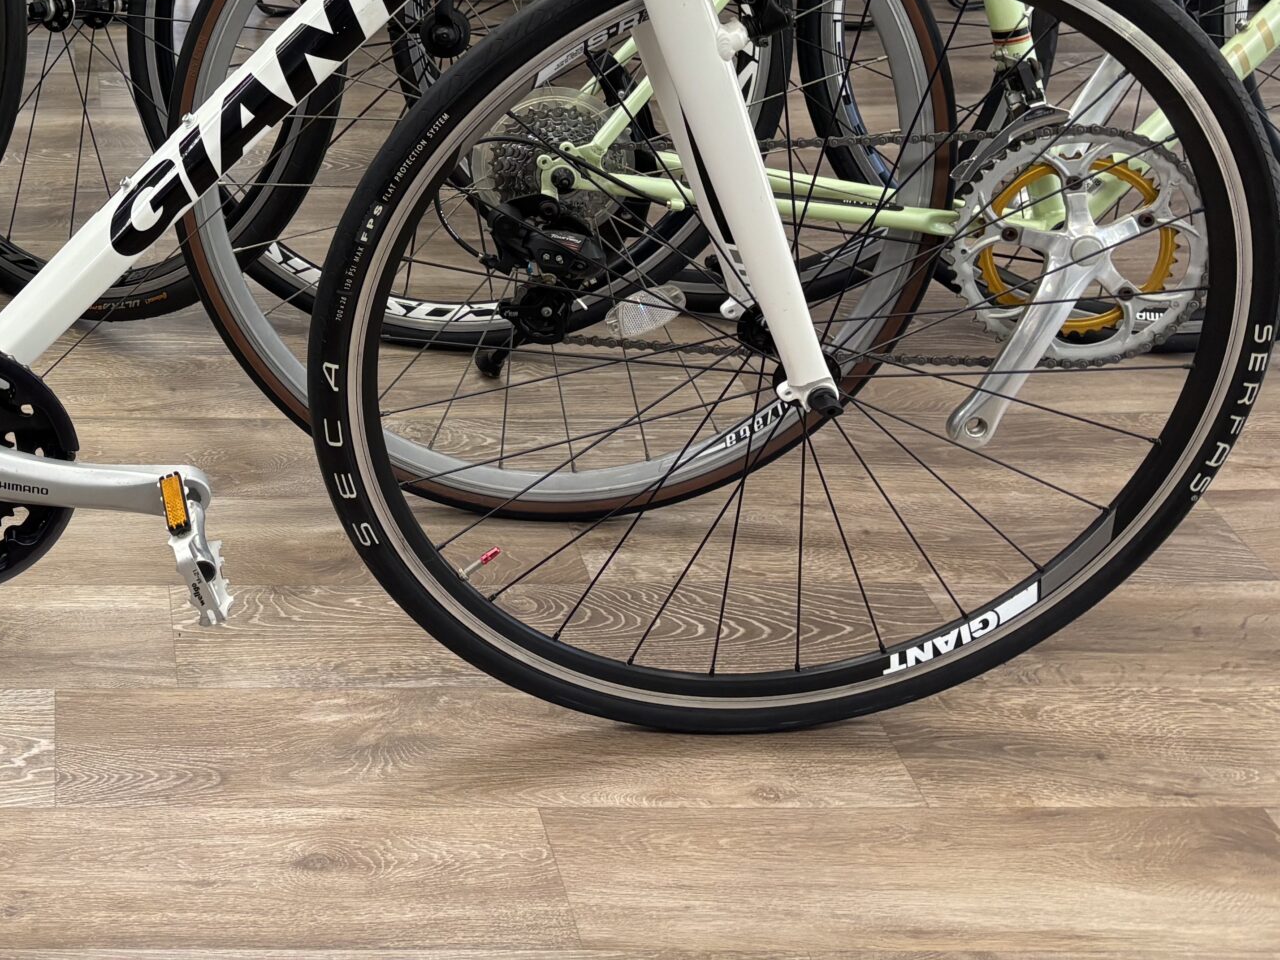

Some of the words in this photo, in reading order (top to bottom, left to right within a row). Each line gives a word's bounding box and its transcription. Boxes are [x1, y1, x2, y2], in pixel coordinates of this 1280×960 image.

[426, 112, 450, 139] SYSTEM
[394, 139, 428, 183] PROTECTION
[382, 183, 397, 202] FLAT
[360, 204, 383, 242] FPS
[353, 246, 365, 263] MAX
[348, 262, 358, 278] PSI
[344, 278, 353, 290] 130
[340, 296, 348, 305] 28
[335, 307, 344, 321] 700
[1191, 323, 1276, 494] SERFAS
[322, 361, 380, 548] SECA
[192, 582, 205, 606] wellgo
[883, 609, 1005, 677] GIANT
